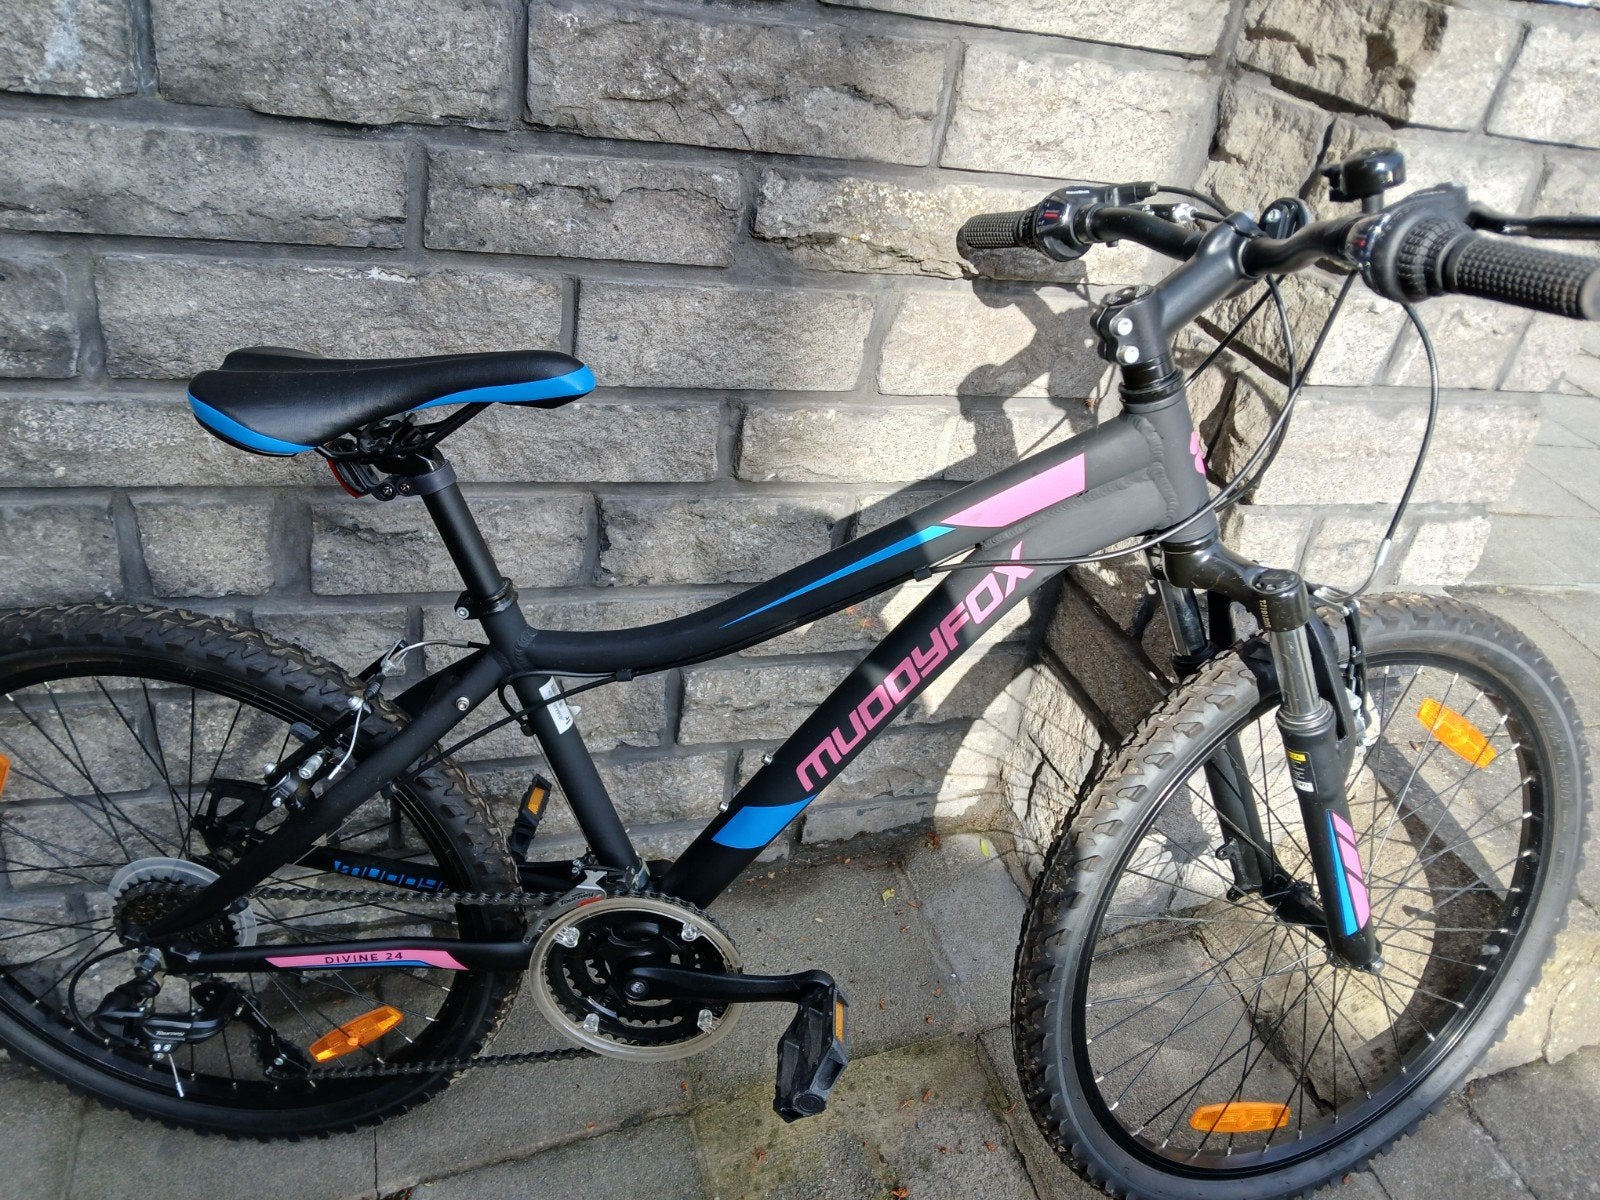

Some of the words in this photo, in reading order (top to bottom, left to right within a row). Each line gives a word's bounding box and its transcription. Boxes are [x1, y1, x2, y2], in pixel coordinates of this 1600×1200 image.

[796, 540, 1035, 792] MUDDYFOX
[325, 953, 379, 964] DIVINE
[385, 952, 403, 960] 24
